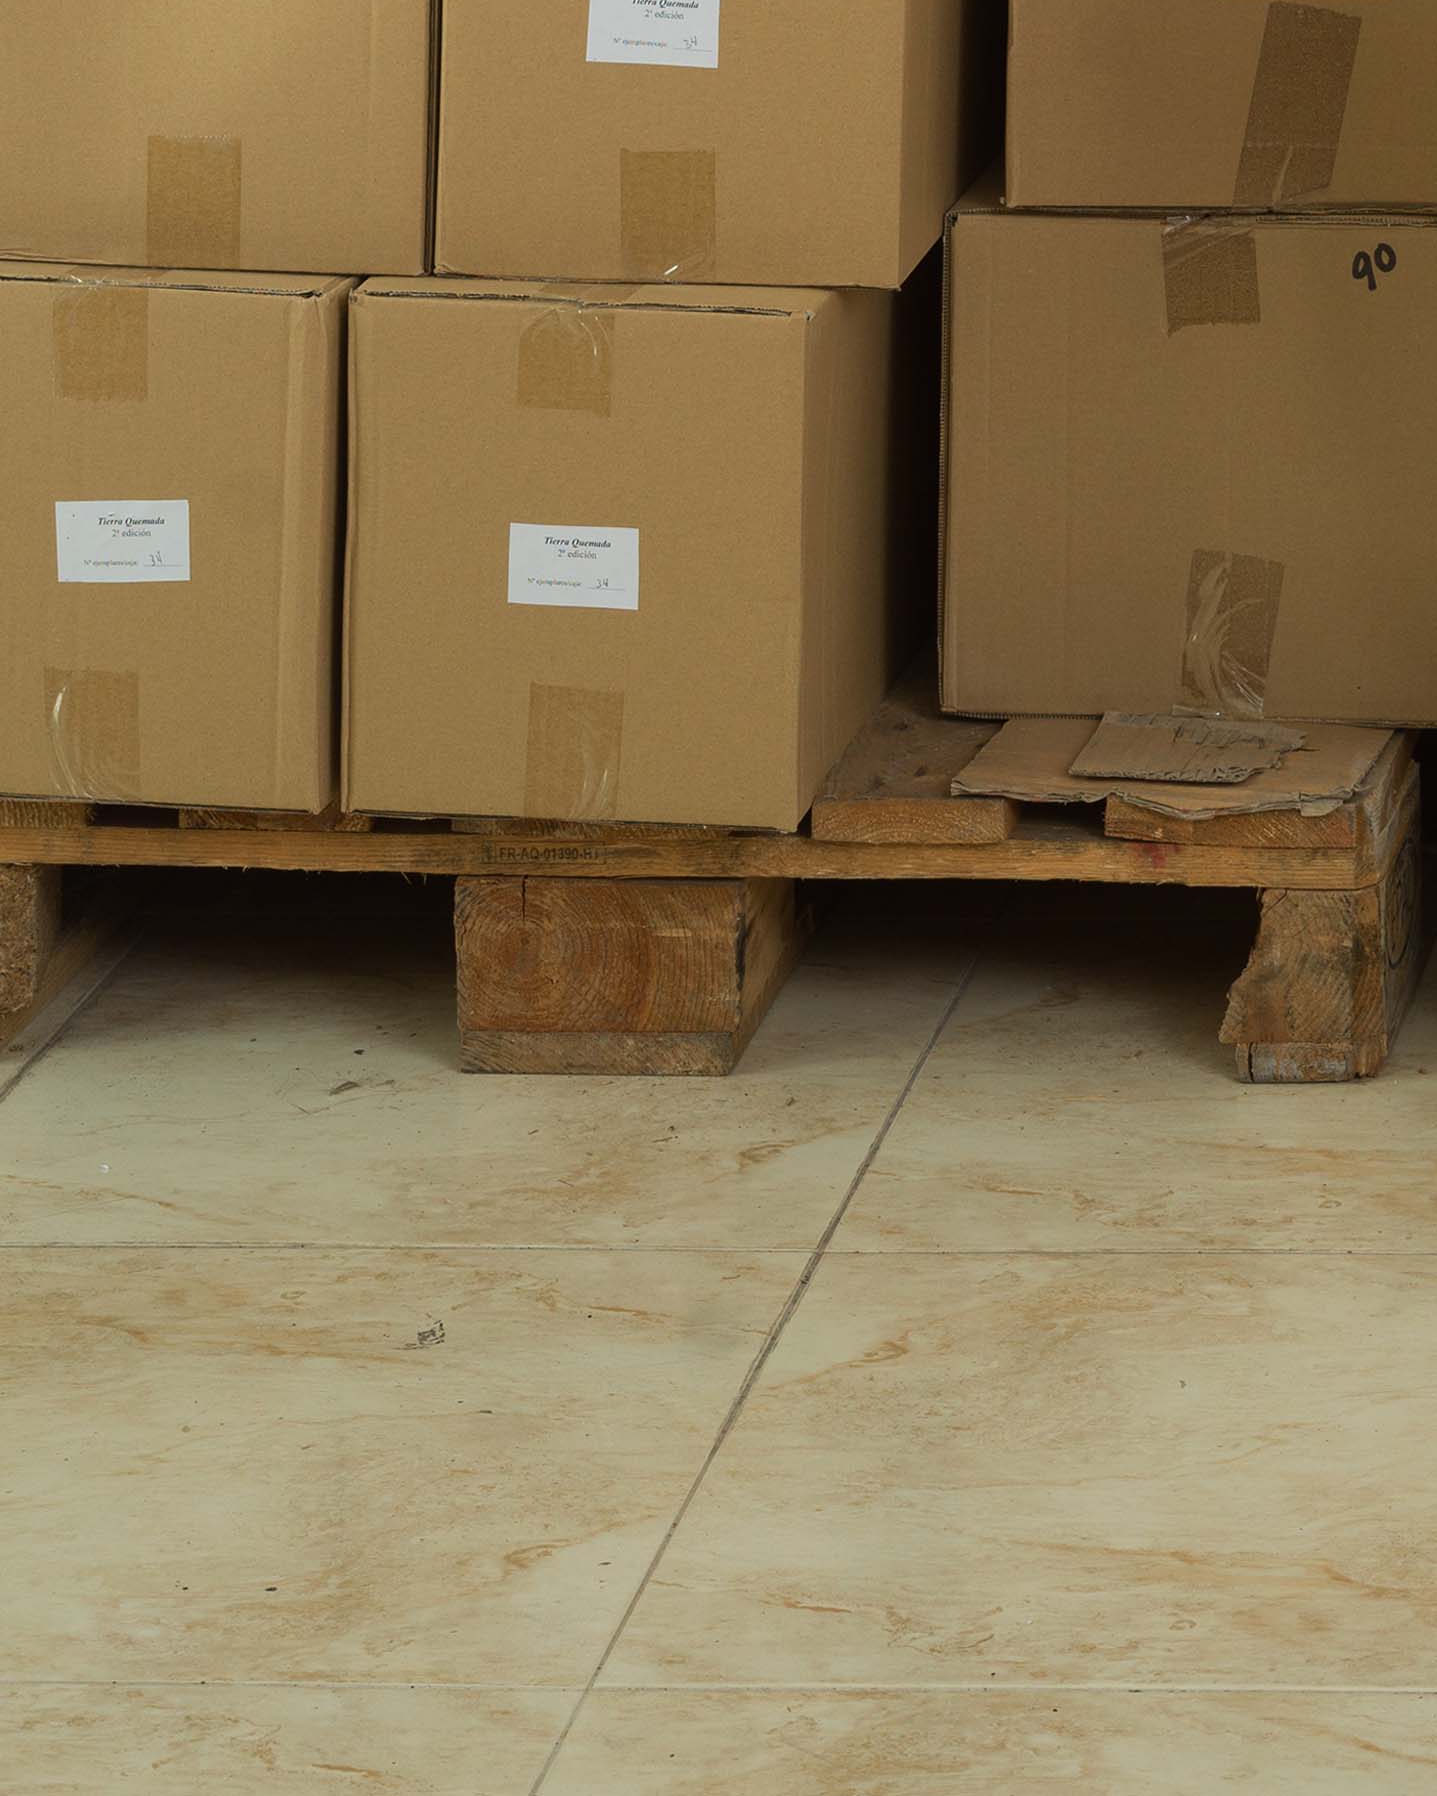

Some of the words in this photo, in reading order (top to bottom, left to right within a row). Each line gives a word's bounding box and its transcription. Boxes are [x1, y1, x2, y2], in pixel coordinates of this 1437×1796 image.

[1352, 242, 1396, 291] 90
[98, 517, 123, 526] Tierra
[125, 517, 165, 528] Quemada
[544, 535, 570, 546] Tierra
[571, 537, 612, 548] Quemada
